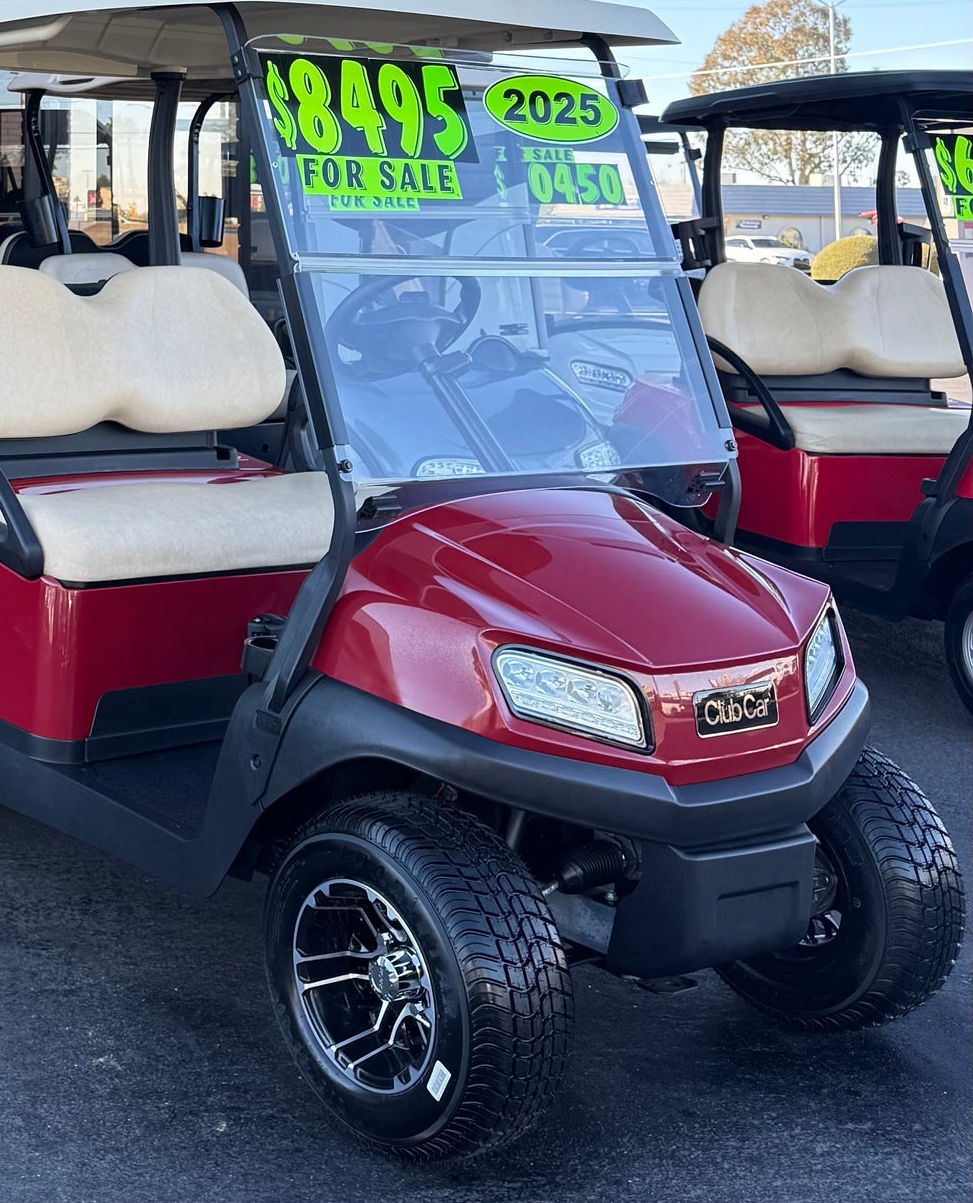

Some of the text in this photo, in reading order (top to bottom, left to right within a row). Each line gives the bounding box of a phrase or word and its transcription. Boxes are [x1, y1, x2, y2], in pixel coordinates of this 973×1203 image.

[267, 59, 468, 159] $8495
[503, 89, 602, 127] 2025
[532, 149, 572, 161] SALE
[303, 158, 368, 191] FOR
[378, 160, 454, 194] SALE
[704, 694, 771, 726] Club Car
